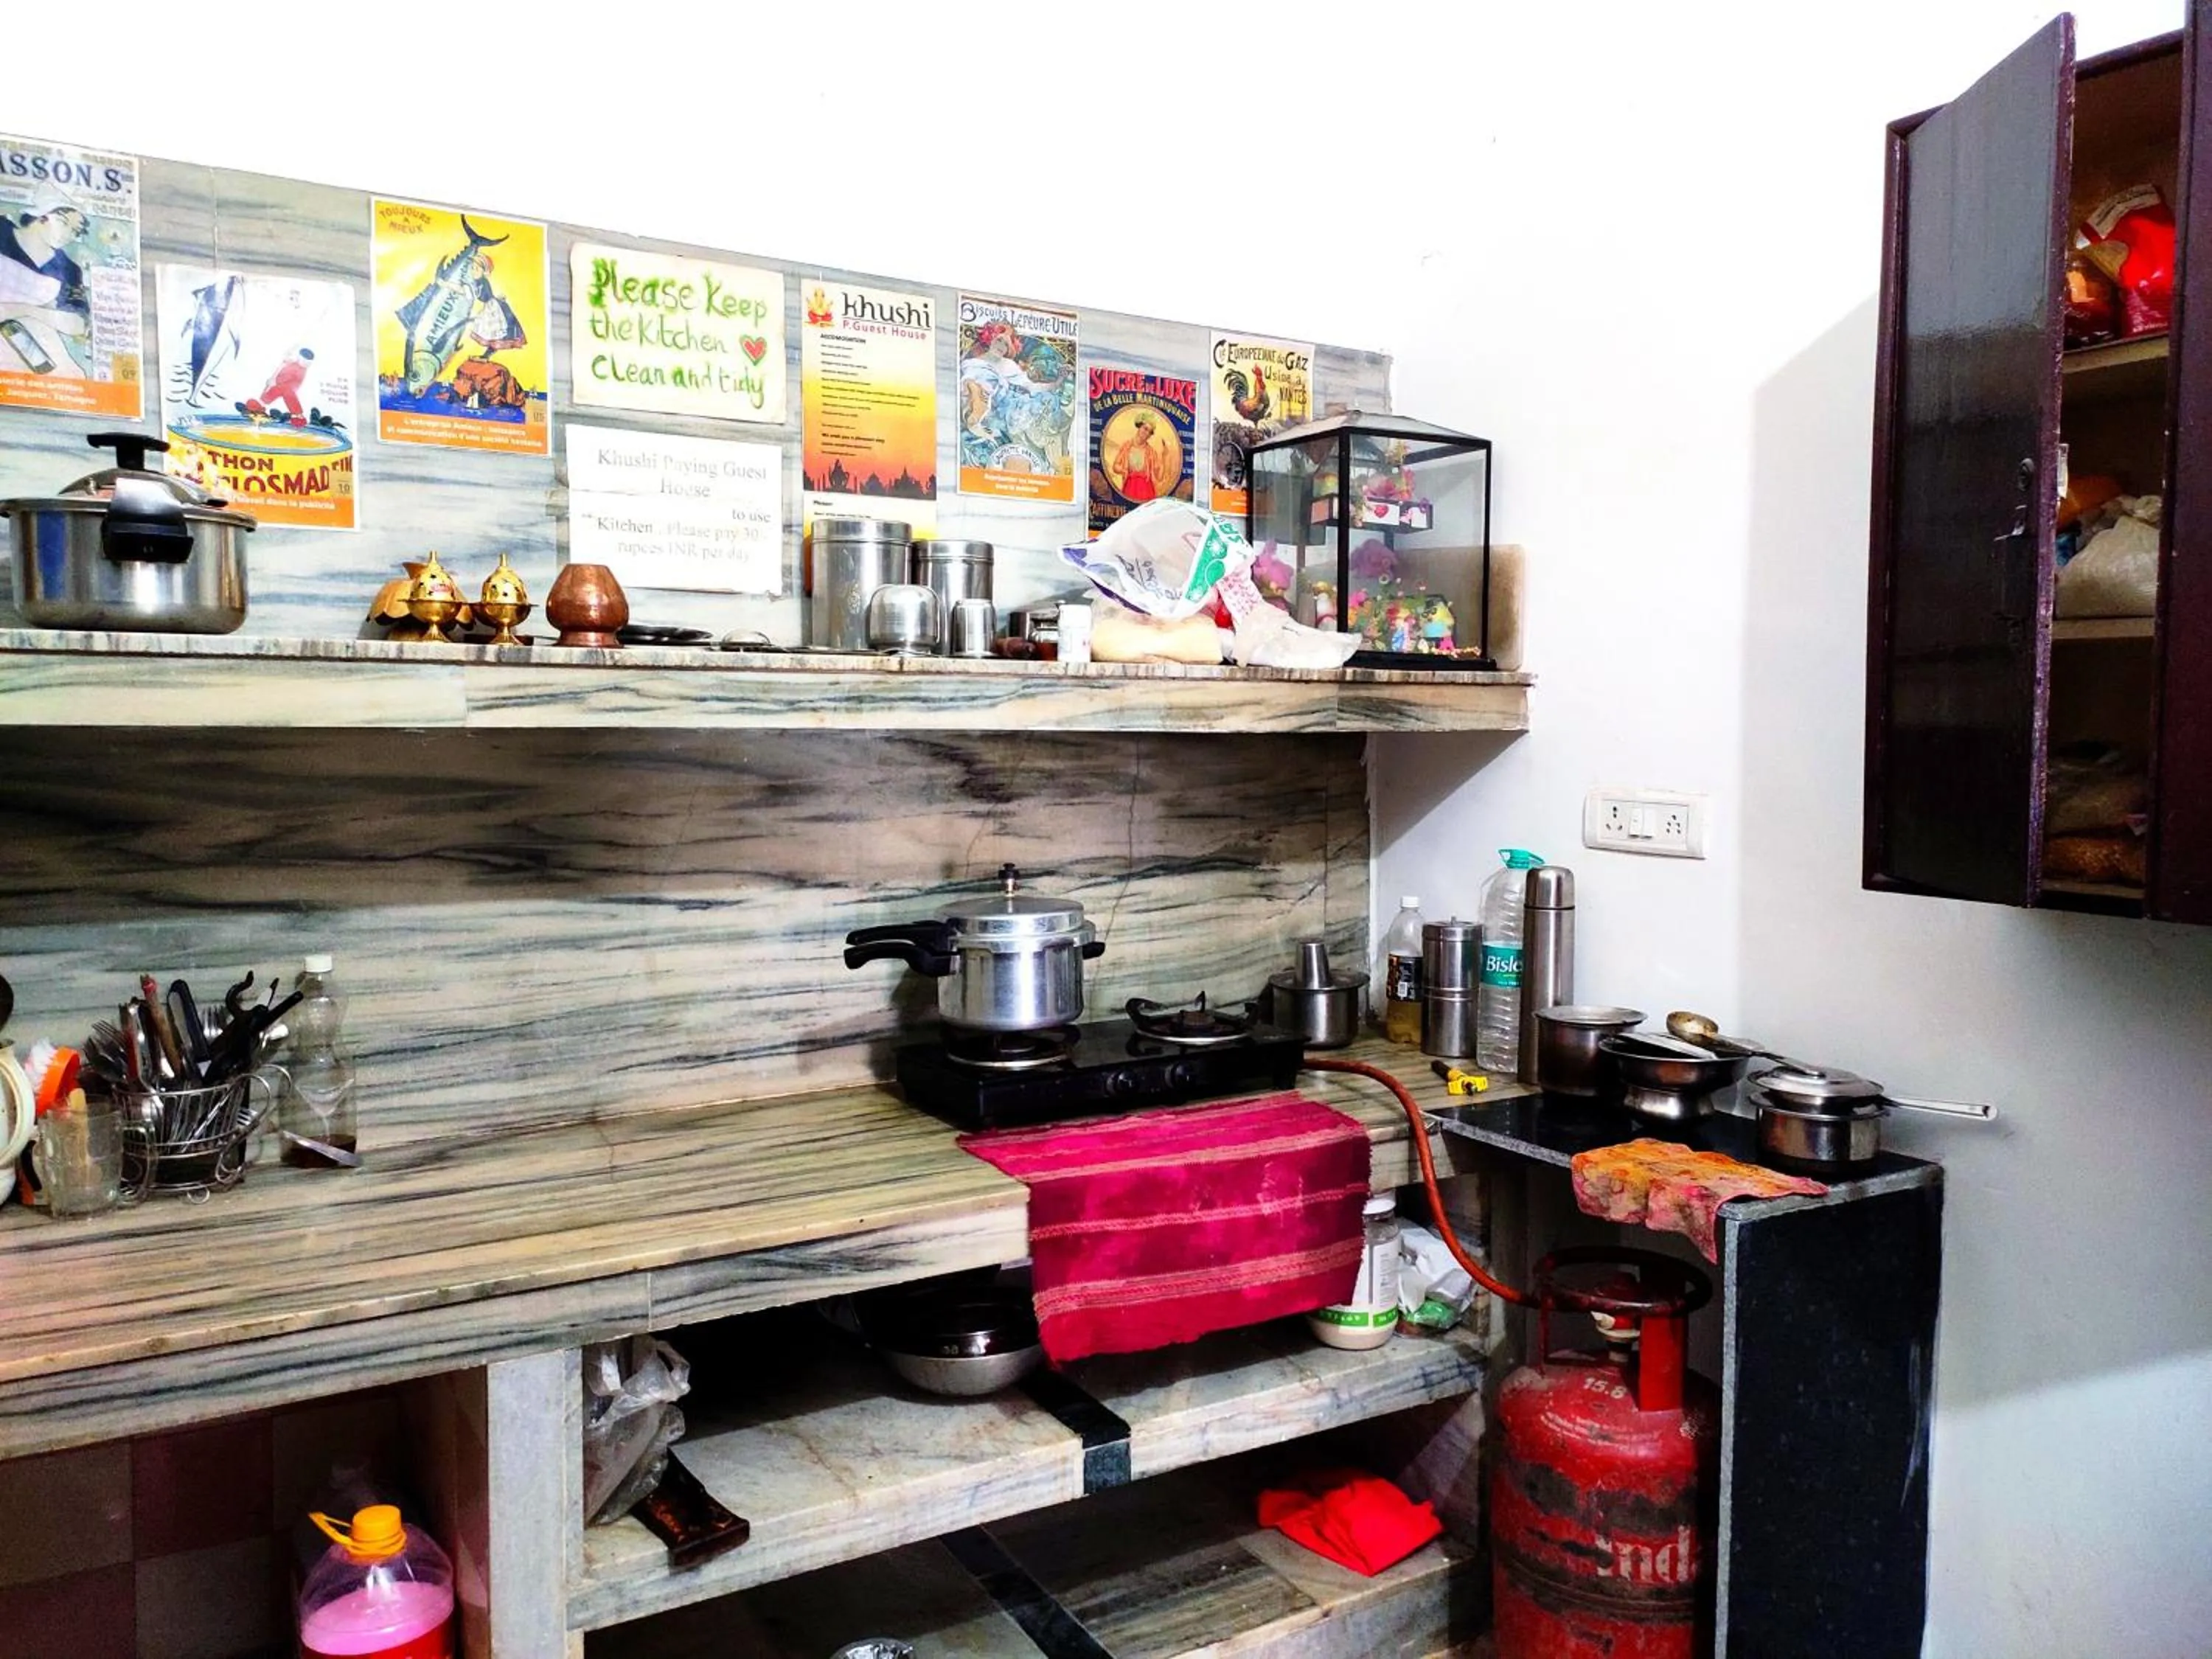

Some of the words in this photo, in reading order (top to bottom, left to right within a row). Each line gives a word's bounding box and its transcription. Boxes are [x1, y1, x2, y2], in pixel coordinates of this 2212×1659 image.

[588, 257, 697, 310] Please
[703, 271, 768, 328] Keep
[425, 289, 459, 347] AMIEUX
[589, 310, 633, 341] the
[891, 327, 927, 340] House
[672, 364, 712, 389] and
[718, 366, 766, 409] tidy
[1089, 365, 1145, 399] SUCRE
[1155, 375, 1197, 414] LUXE
[1113, 393, 1134, 406] BELLE
[207, 451, 274, 473] THON
[598, 448, 658, 470] Khushi
[663, 454, 718, 479] Paying
[723, 461, 767, 480] Guest
[661, 478, 711, 498] House
[731, 509, 745, 521] to
[749, 512, 772, 524] use
[1486, 955, 1523, 973] Bisle
[1594, 1525, 1691, 1585] Ind
